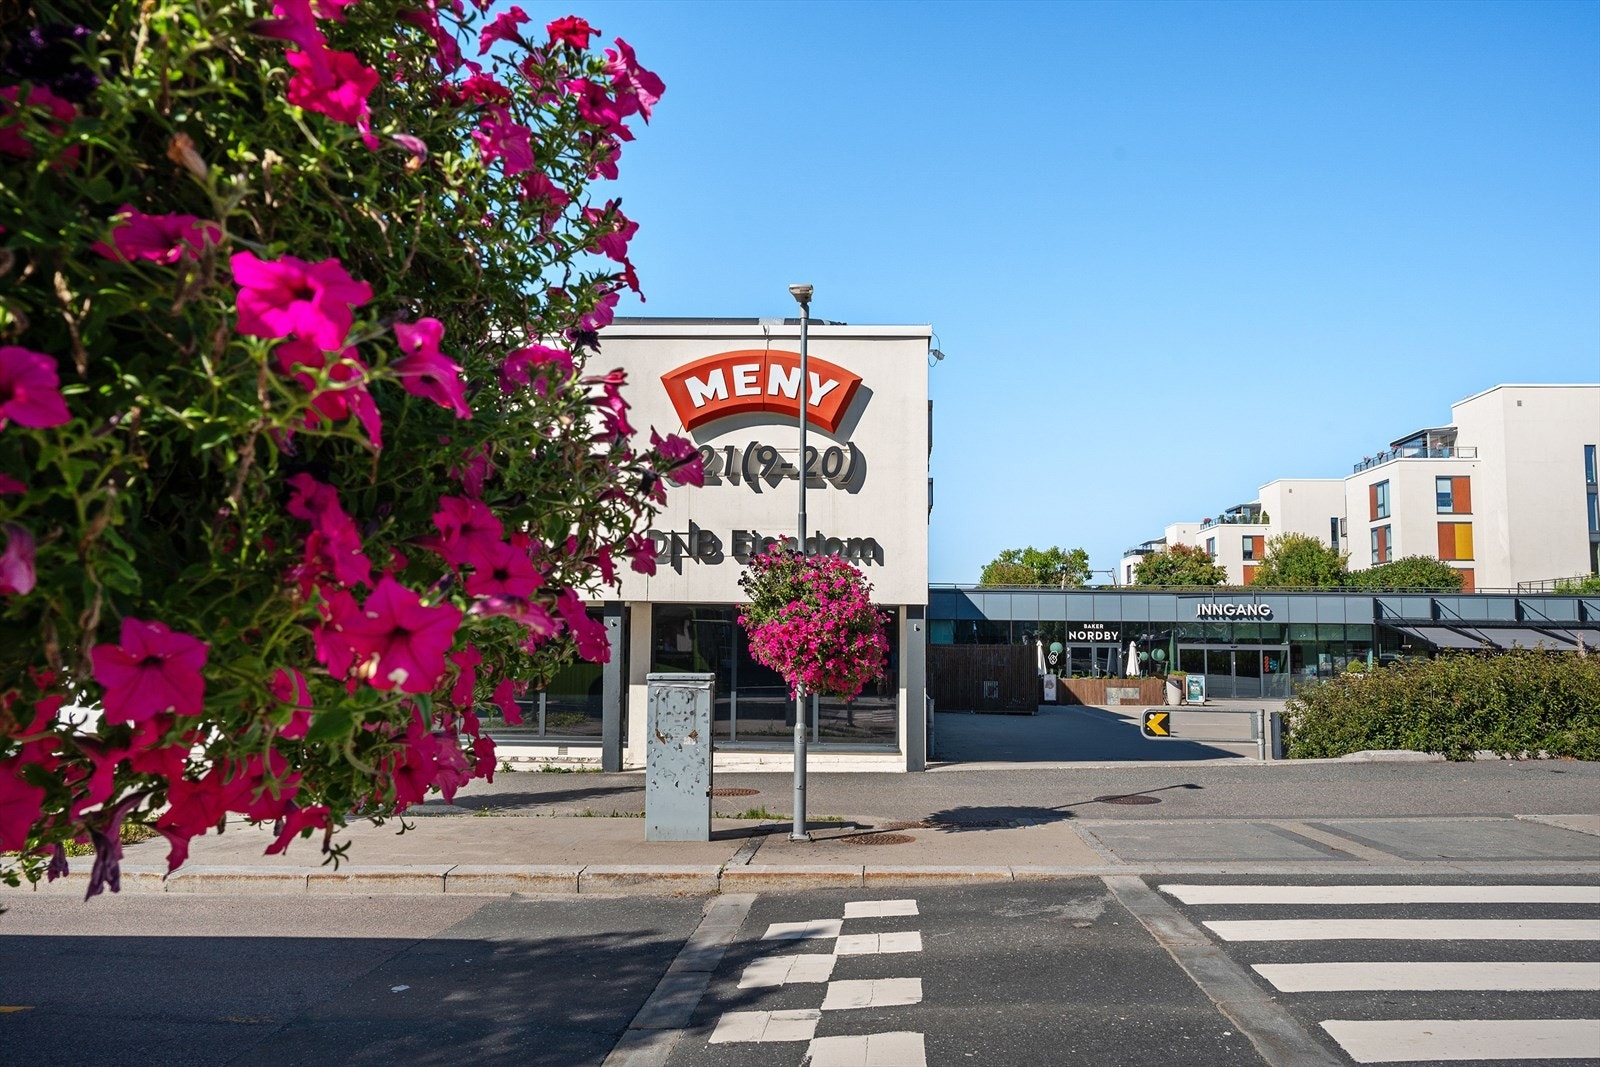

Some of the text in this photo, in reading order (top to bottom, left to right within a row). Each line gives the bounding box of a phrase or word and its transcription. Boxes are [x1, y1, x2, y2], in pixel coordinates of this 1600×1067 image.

[684, 363, 840, 408] MENY
[1196, 603, 1271, 616] INNGANG
[1068, 631, 1119, 641] NORDBY
